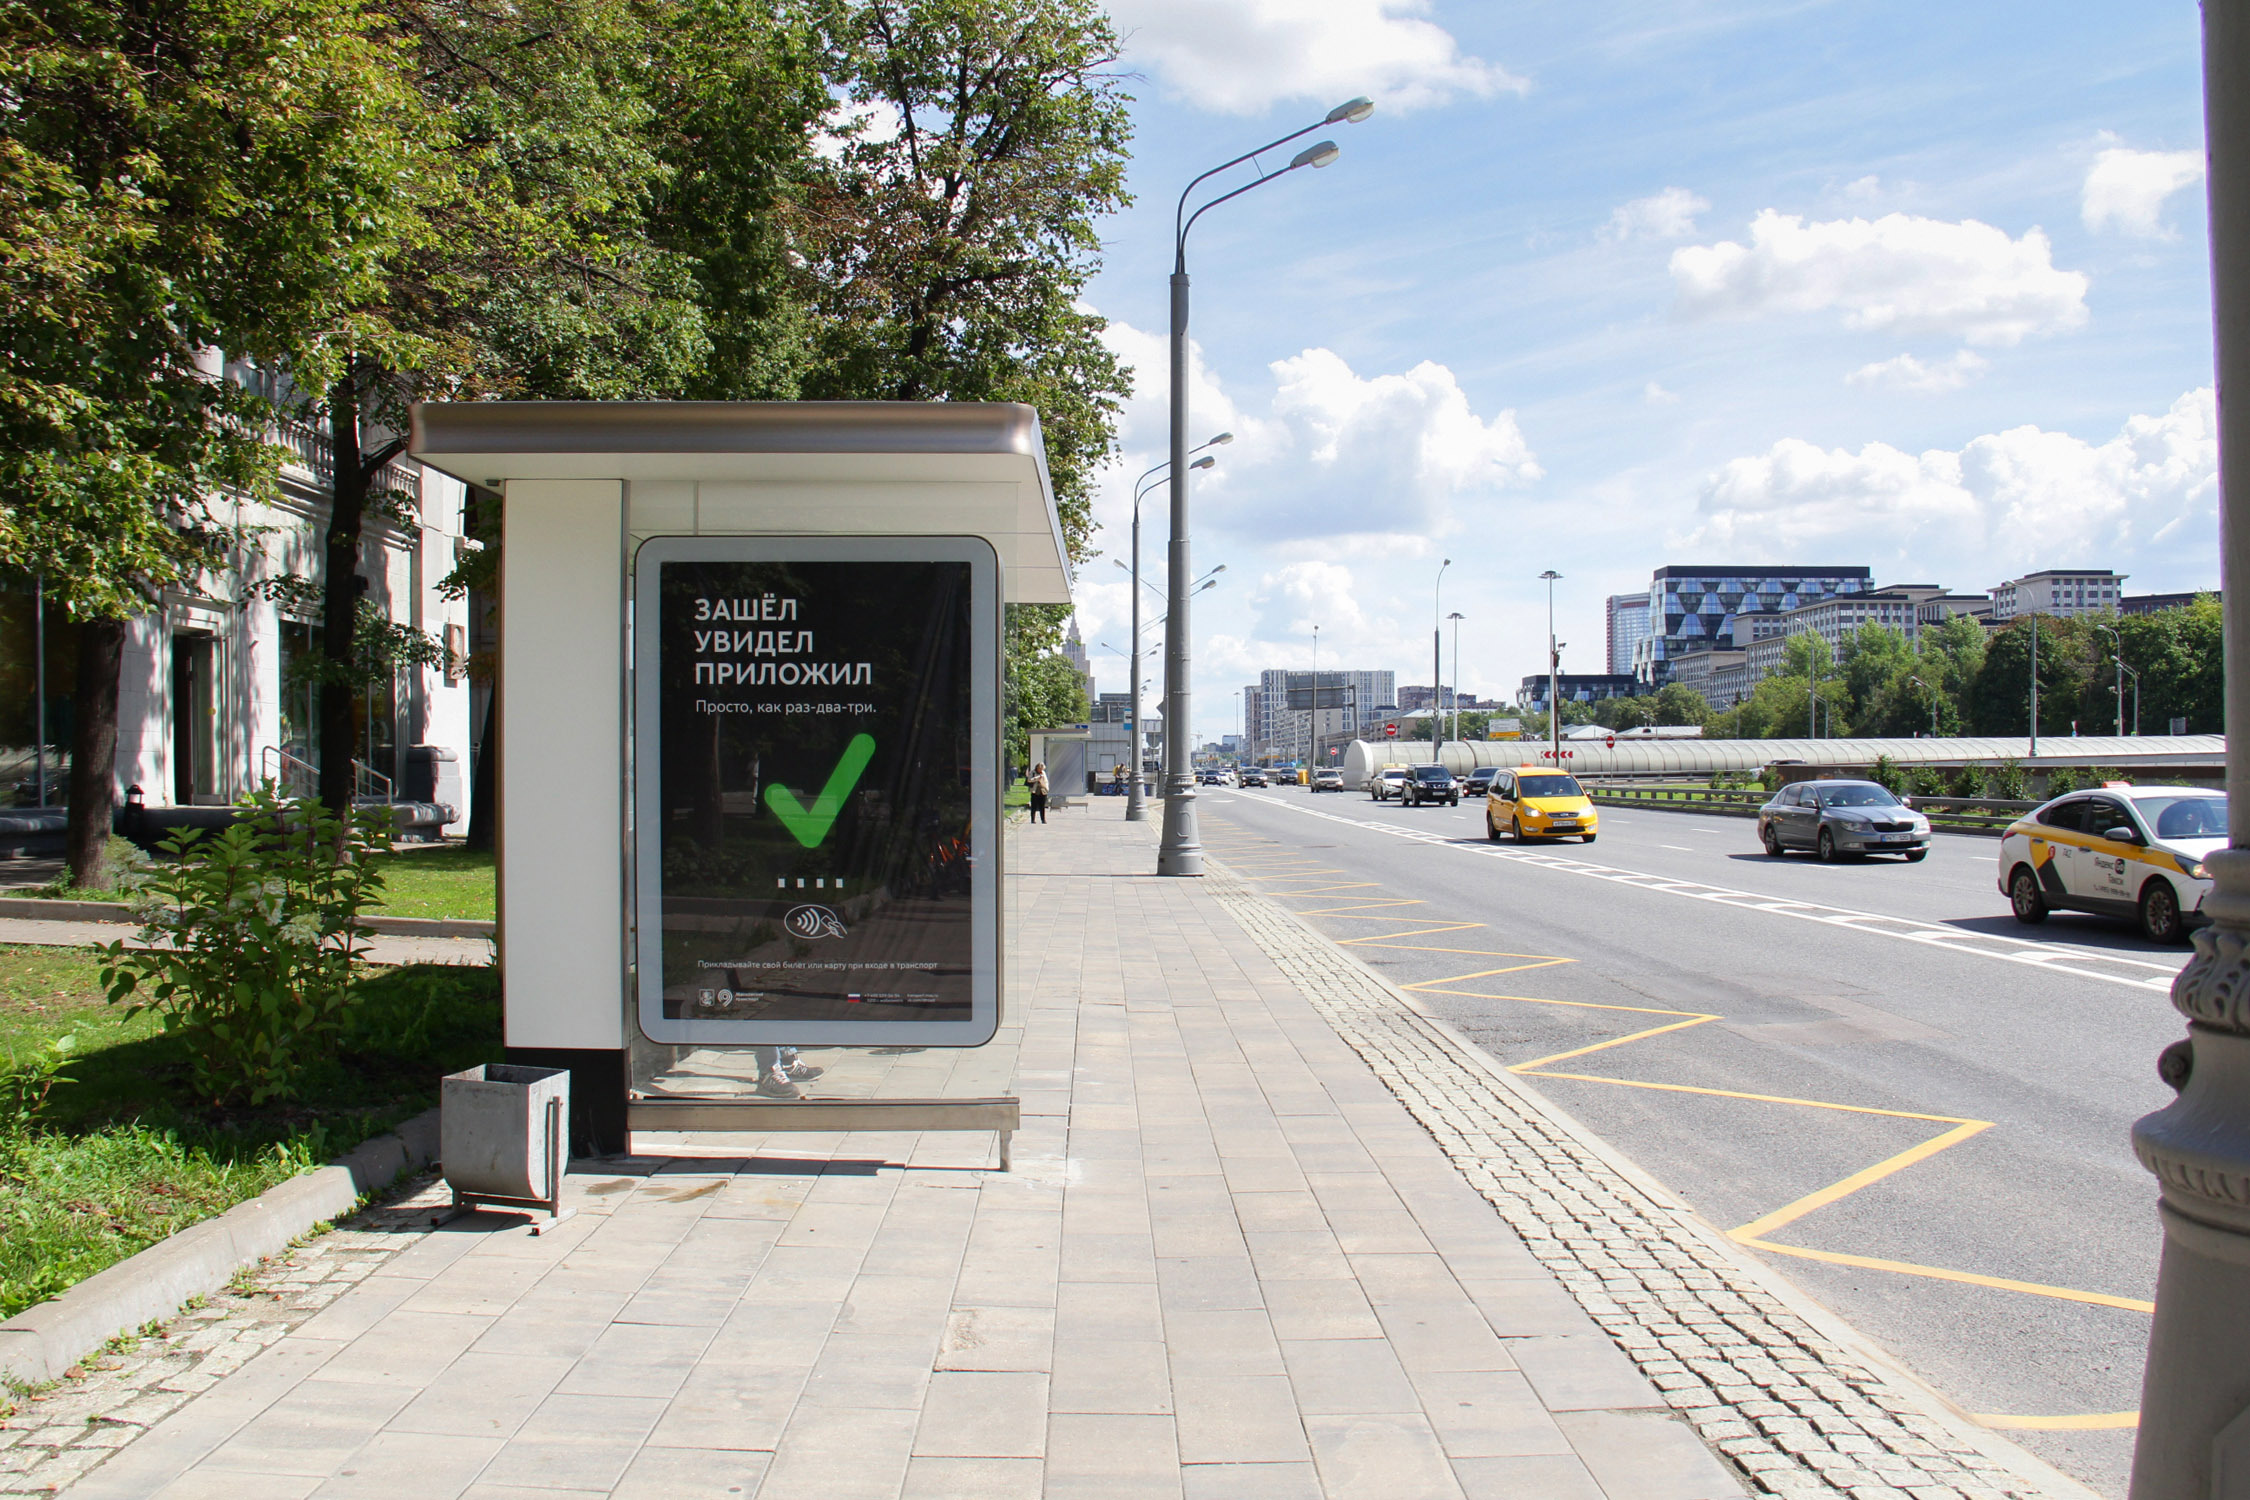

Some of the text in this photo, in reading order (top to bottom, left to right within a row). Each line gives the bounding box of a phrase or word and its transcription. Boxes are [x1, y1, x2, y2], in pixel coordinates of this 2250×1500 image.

[694, 593, 797, 621] ЗАШЁЛ
[694, 631, 813, 657] УВИДЕЛ
[695, 663, 872, 685] ПРИЛОЖИЛ
[696, 700, 877, 716] Просто, как раз-два-три.
[697, 960, 760, 970] Прикладывайте
[762, 961, 780, 969] свой
[782, 961, 806, 969] билет
[824, 962, 846, 971] карту
[848, 962, 864, 970] при
[865, 962, 888, 970] входе
[896, 962, 938, 970] транспорт
